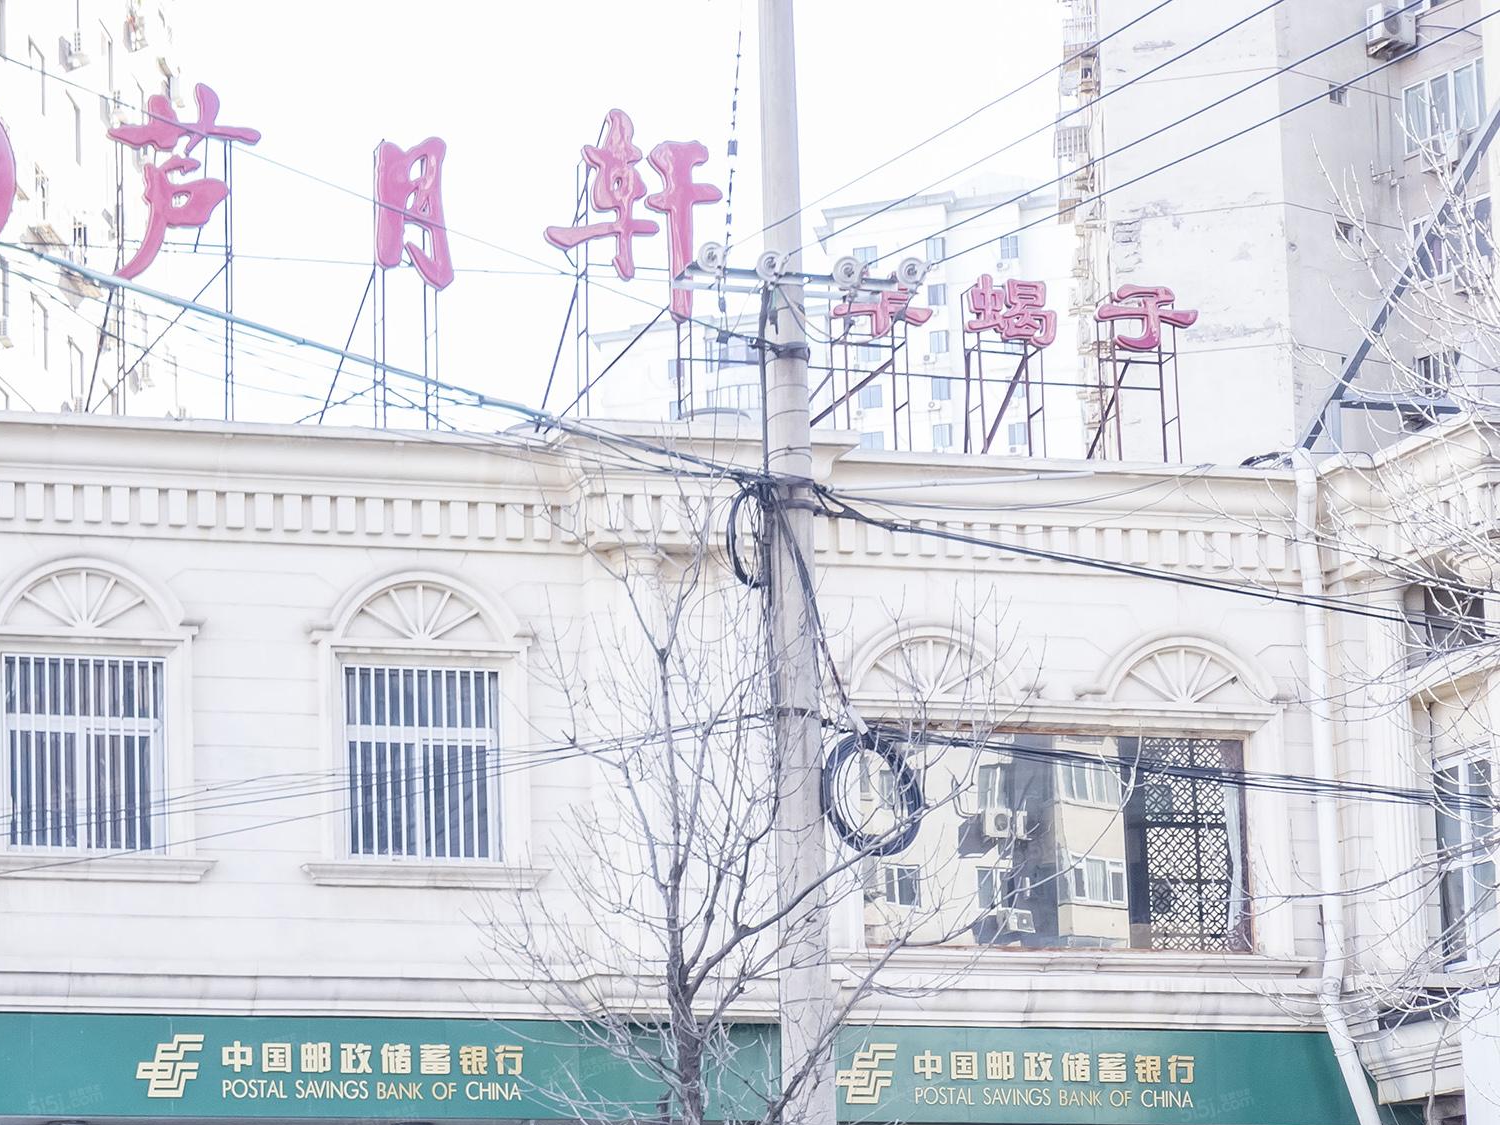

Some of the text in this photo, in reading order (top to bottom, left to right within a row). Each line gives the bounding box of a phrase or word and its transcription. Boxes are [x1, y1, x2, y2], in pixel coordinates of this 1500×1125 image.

[221, 1040, 524, 1076] 中国邮政储蓄银行
[912, 1049, 1196, 1084] 中国邮政储蓄银行
[221, 1079, 523, 1102] POSTAL SAVINGS BANK OF CHINA
[914, 1086, 1194, 1109] POSTAL SAVINGS BANK OF CHINA
